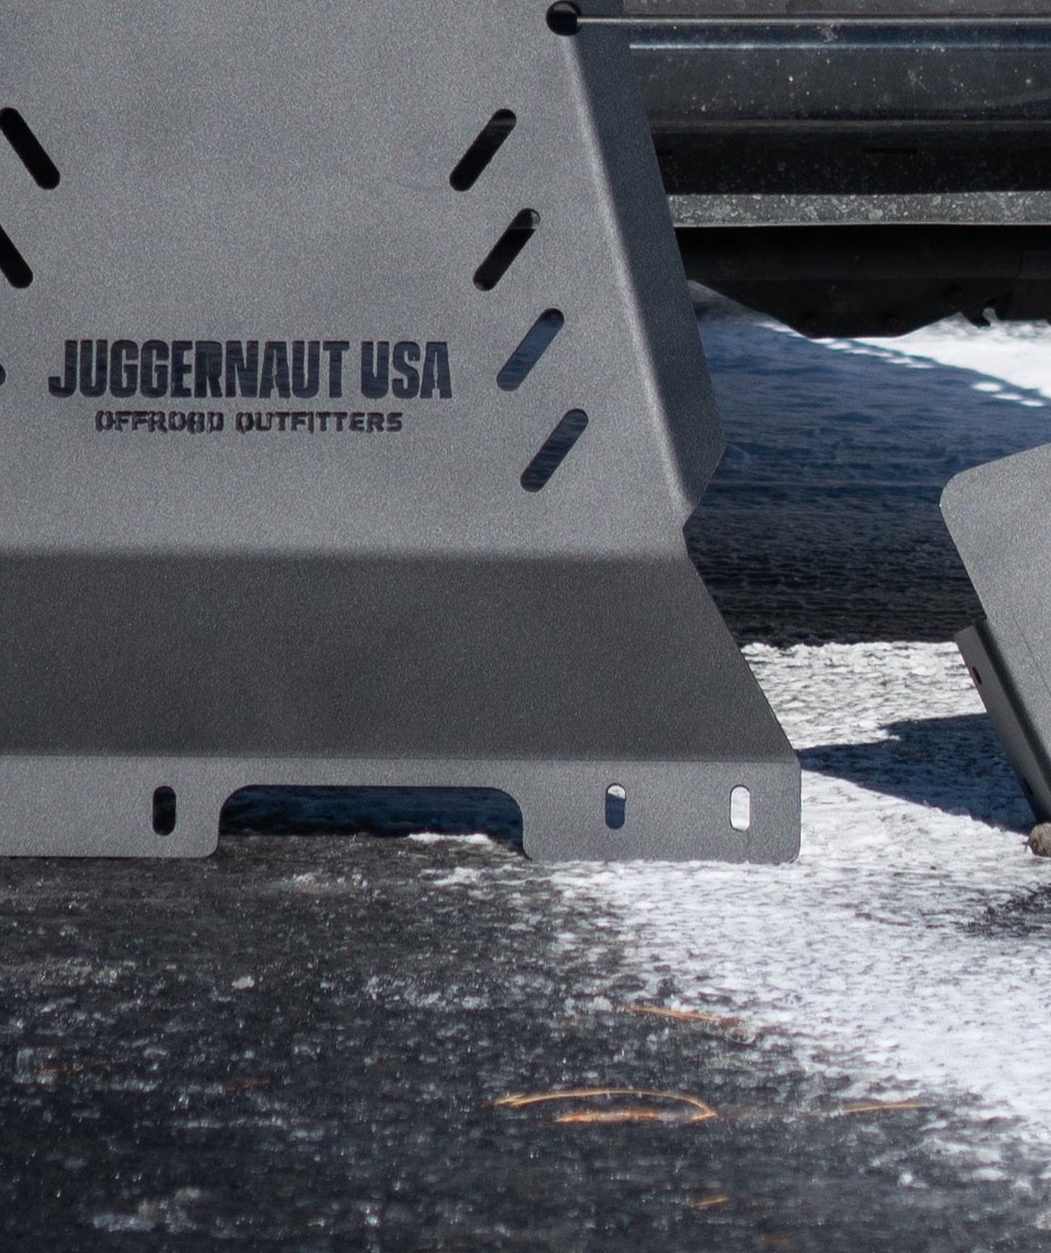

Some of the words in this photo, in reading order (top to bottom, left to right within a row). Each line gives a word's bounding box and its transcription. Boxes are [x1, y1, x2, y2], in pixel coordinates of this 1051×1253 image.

[48, 339, 350, 399] JUGGERNAUT
[360, 340, 453, 400] USA
[95, 410, 224, 434] OFFROAD
[235, 410, 403, 434] OUTFITTERS
